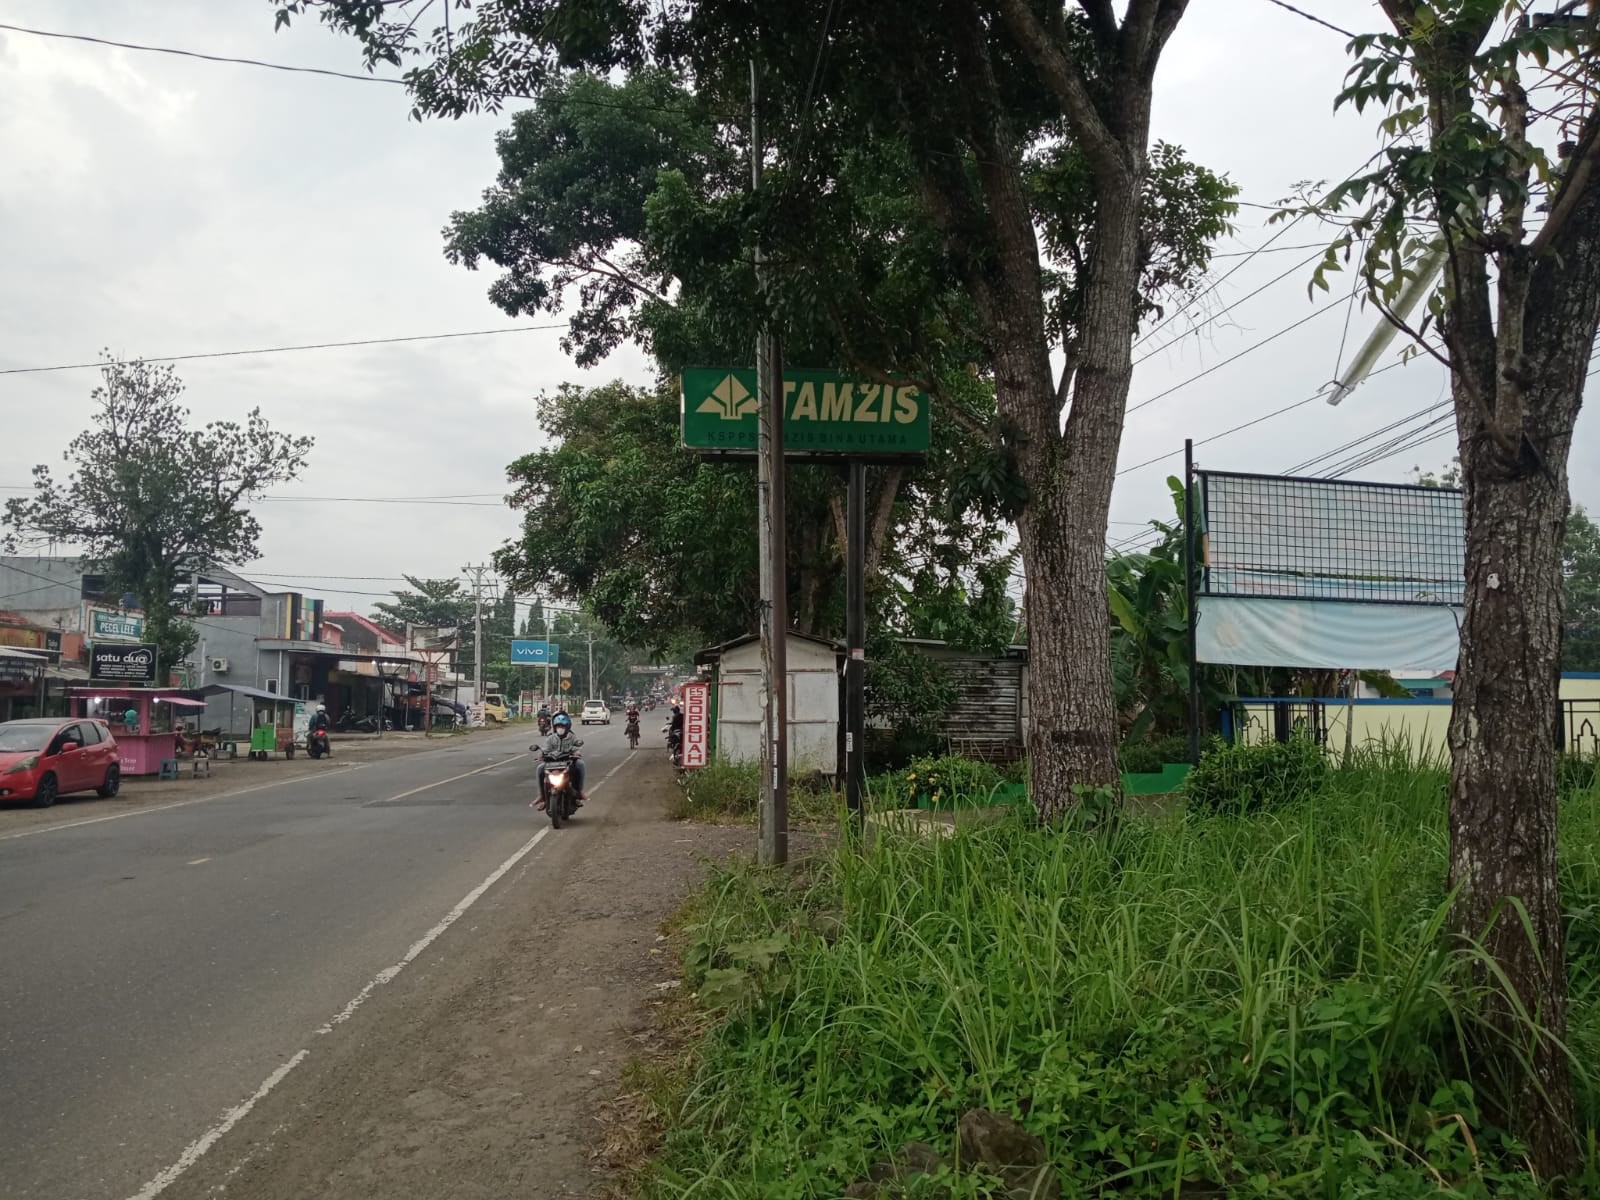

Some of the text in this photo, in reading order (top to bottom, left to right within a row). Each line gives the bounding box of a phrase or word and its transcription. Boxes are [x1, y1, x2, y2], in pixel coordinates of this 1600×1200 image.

[707, 431, 756, 442] KSPPS
[858, 434, 907, 444] UTAMA
[100, 622, 135, 635] PECEL LELE
[96, 654, 120, 662] satu
